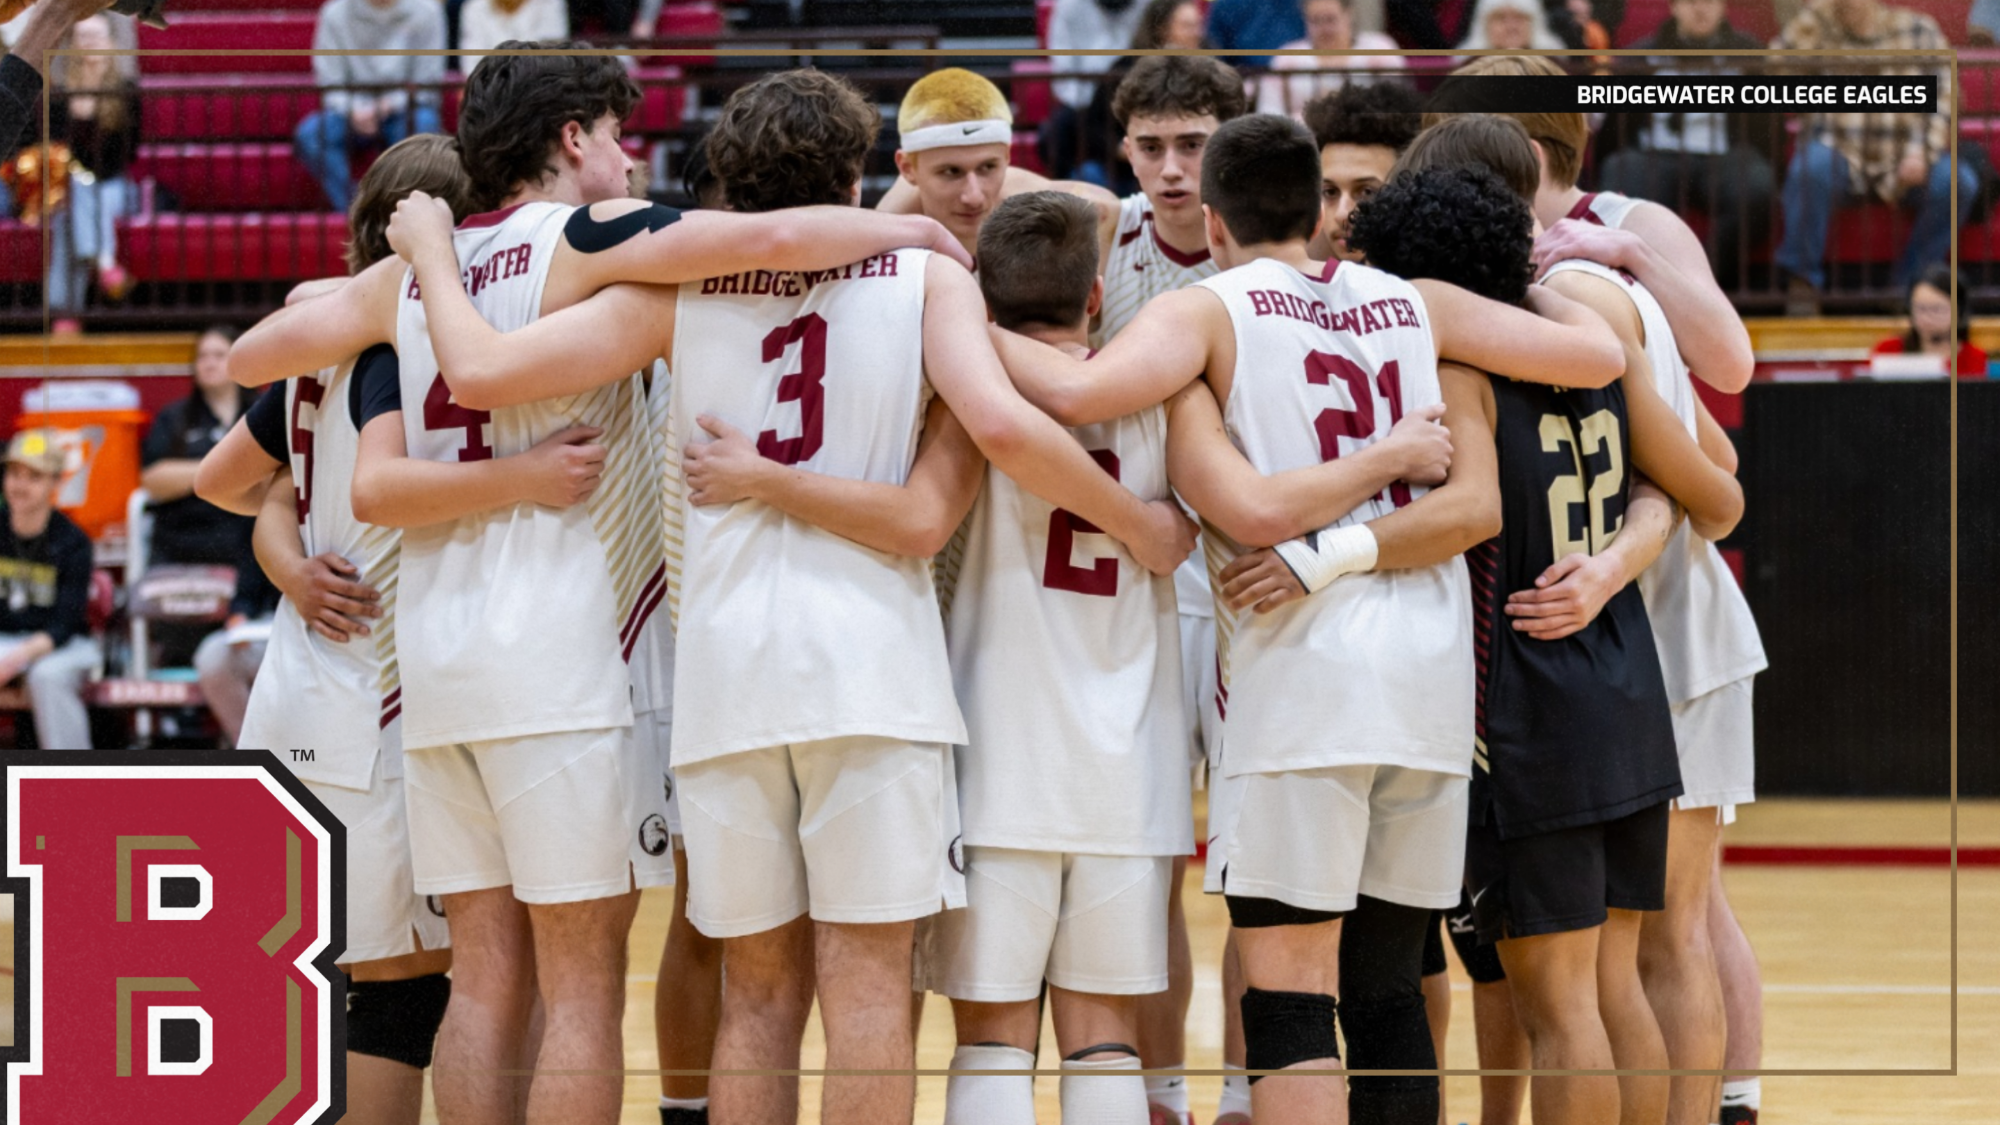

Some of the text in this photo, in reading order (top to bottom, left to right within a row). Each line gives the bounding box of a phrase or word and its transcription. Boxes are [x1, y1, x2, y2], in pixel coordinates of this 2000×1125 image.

[1246, 289, 1421, 337] BRIDGEWATER
[291, 375, 326, 525] 5
[423, 370, 493, 463] 4
[755, 311, 828, 466] 3
[1303, 348, 1413, 508] 21
[1043, 448, 1121, 597] 2
[1538, 408, 1624, 565] 22
